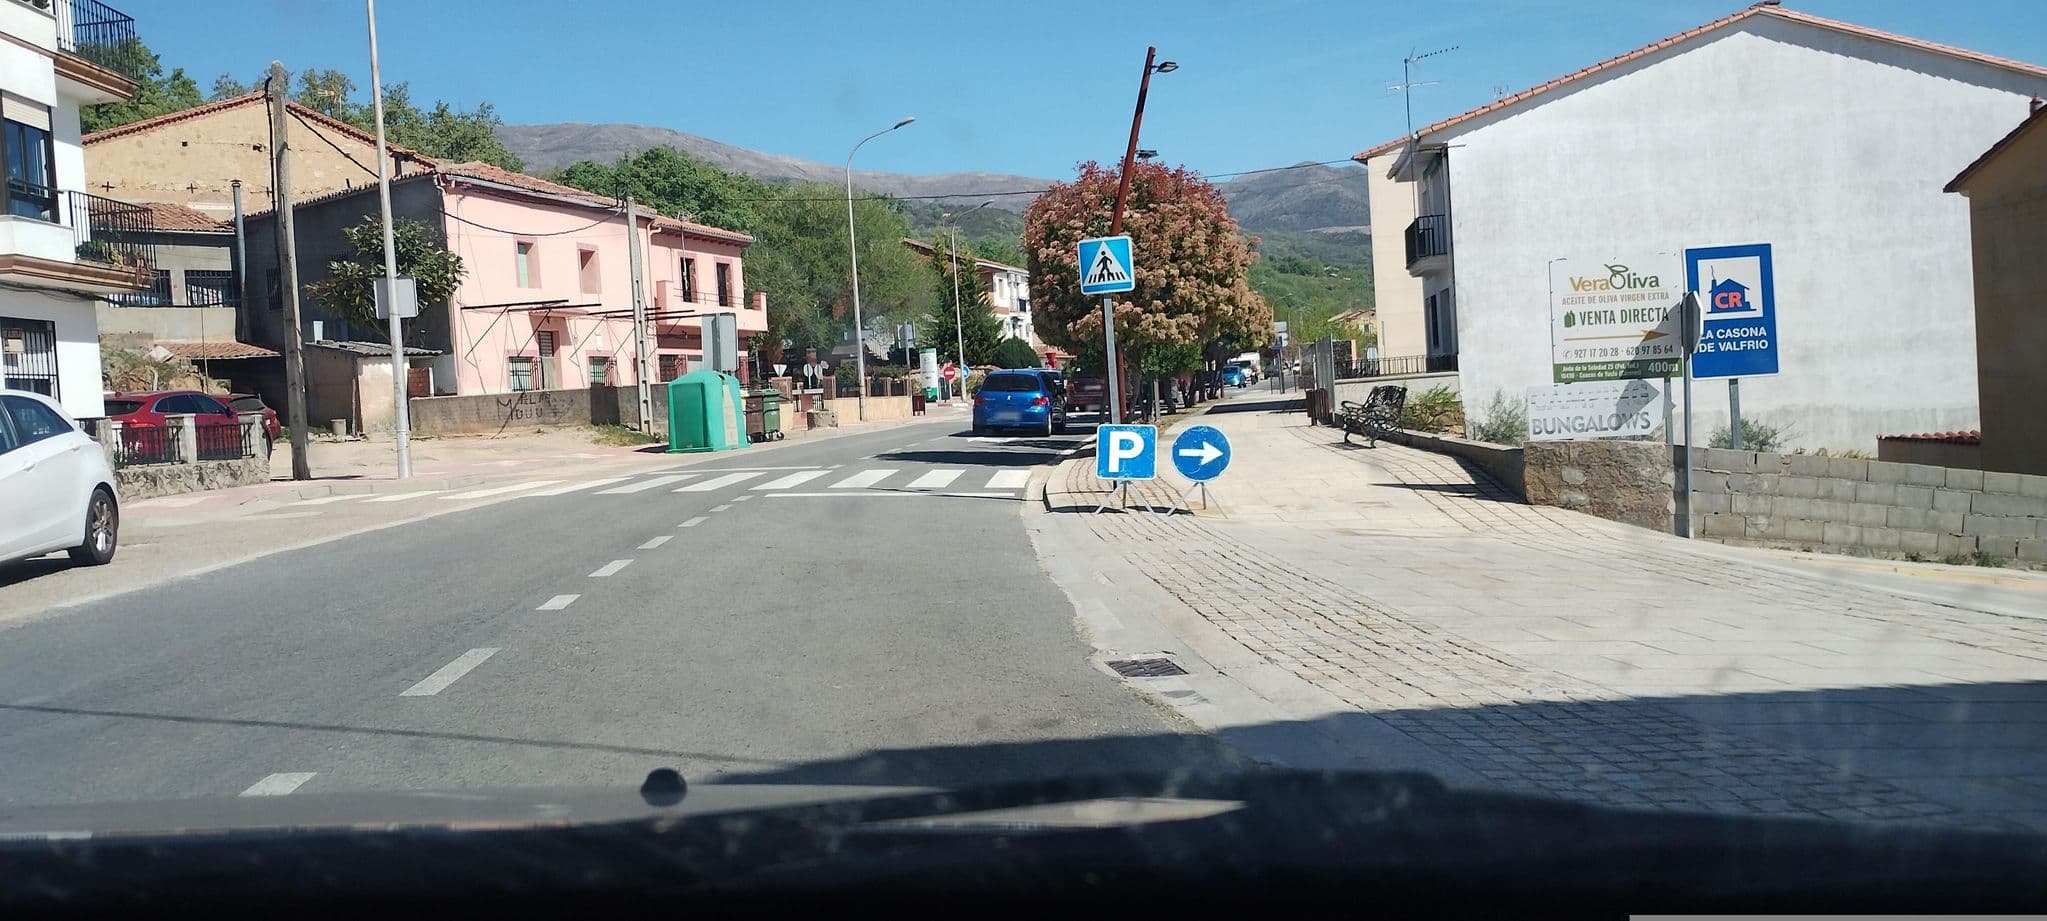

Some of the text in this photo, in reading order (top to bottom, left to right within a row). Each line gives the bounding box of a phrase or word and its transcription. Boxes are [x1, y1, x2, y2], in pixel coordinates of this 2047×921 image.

[1562, 292, 1670, 305] ACEITE DE OLIVA VIRGEN EXTRA
[1715, 292, 1742, 308] CR
[1579, 307, 1669, 326] VENTA DIRECTA
[1716, 327, 1767, 338] CASONA
[1574, 344, 1673, 358] 927 17 20 28 620 97 85 64
[1699, 340, 1769, 353] DE VALFRIO
[1532, 412, 1651, 435] BUNGALOWS
[1109, 431, 1145, 473] P
